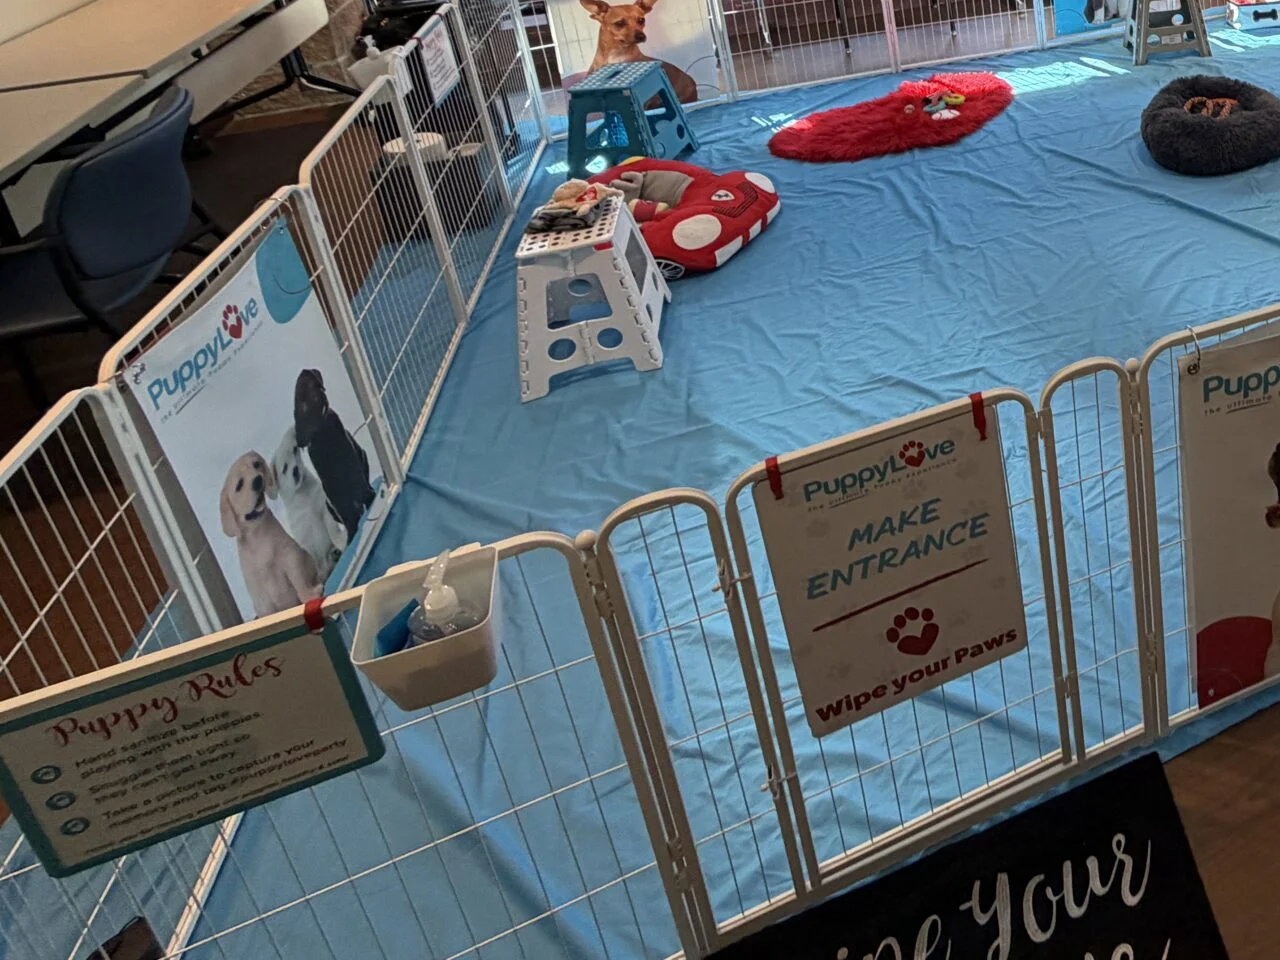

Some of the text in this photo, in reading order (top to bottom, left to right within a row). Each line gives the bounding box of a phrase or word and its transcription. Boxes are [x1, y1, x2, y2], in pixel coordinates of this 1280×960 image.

[848, 498, 941, 550] MAKE
[806, 513, 990, 600] ENTRANCE
[50, 652, 285, 746] Puppy Rules
[816, 629, 1017, 722] Wipe your Paws
[75, 710, 229, 768] Hand sanitize before
[81, 755, 136, 779] playing
[141, 742, 172, 756] with
[175, 733, 199, 745] the
[88, 768, 151, 794] Snuggle
[155, 754, 192, 770] them
[196, 740, 233, 757] tight
[102, 803, 137, 819] Take
[156, 779, 206, 802] picture
[210, 771, 225, 782] to
[227, 751, 281, 776] capture
[283, 739, 315, 756] your
[132, 774, 168, 791] can't
[171, 764, 195, 779] get
[200, 751, 236, 768] away
[108, 804, 168, 829] memory
[172, 792, 199, 808] and
[203, 781, 227, 796] tag
[958, 833, 1152, 960] your
